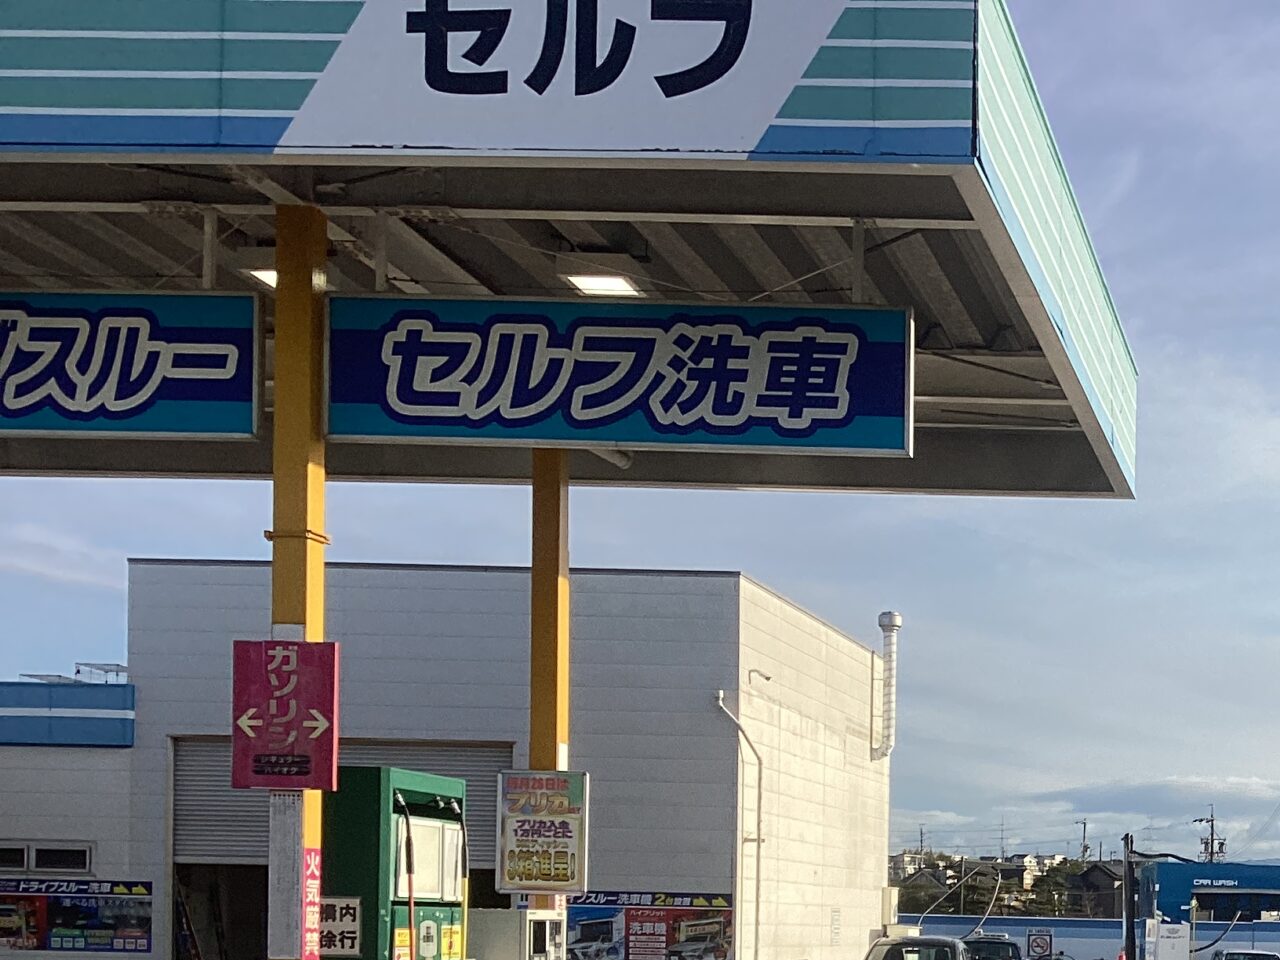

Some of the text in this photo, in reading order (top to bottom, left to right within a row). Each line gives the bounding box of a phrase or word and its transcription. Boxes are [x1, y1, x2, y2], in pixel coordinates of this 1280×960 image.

[406, 0, 752, 98] セルフ
[381, 319, 859, 429] セルフ洗車
[267, 646, 299, 750] ガソリン
[515, 820, 571, 830] プリカ入金
[305, 851, 320, 956] 火気厳禁
[1213, 879, 1239, 887] WASH
[319, 930, 358, 949] 徐行
